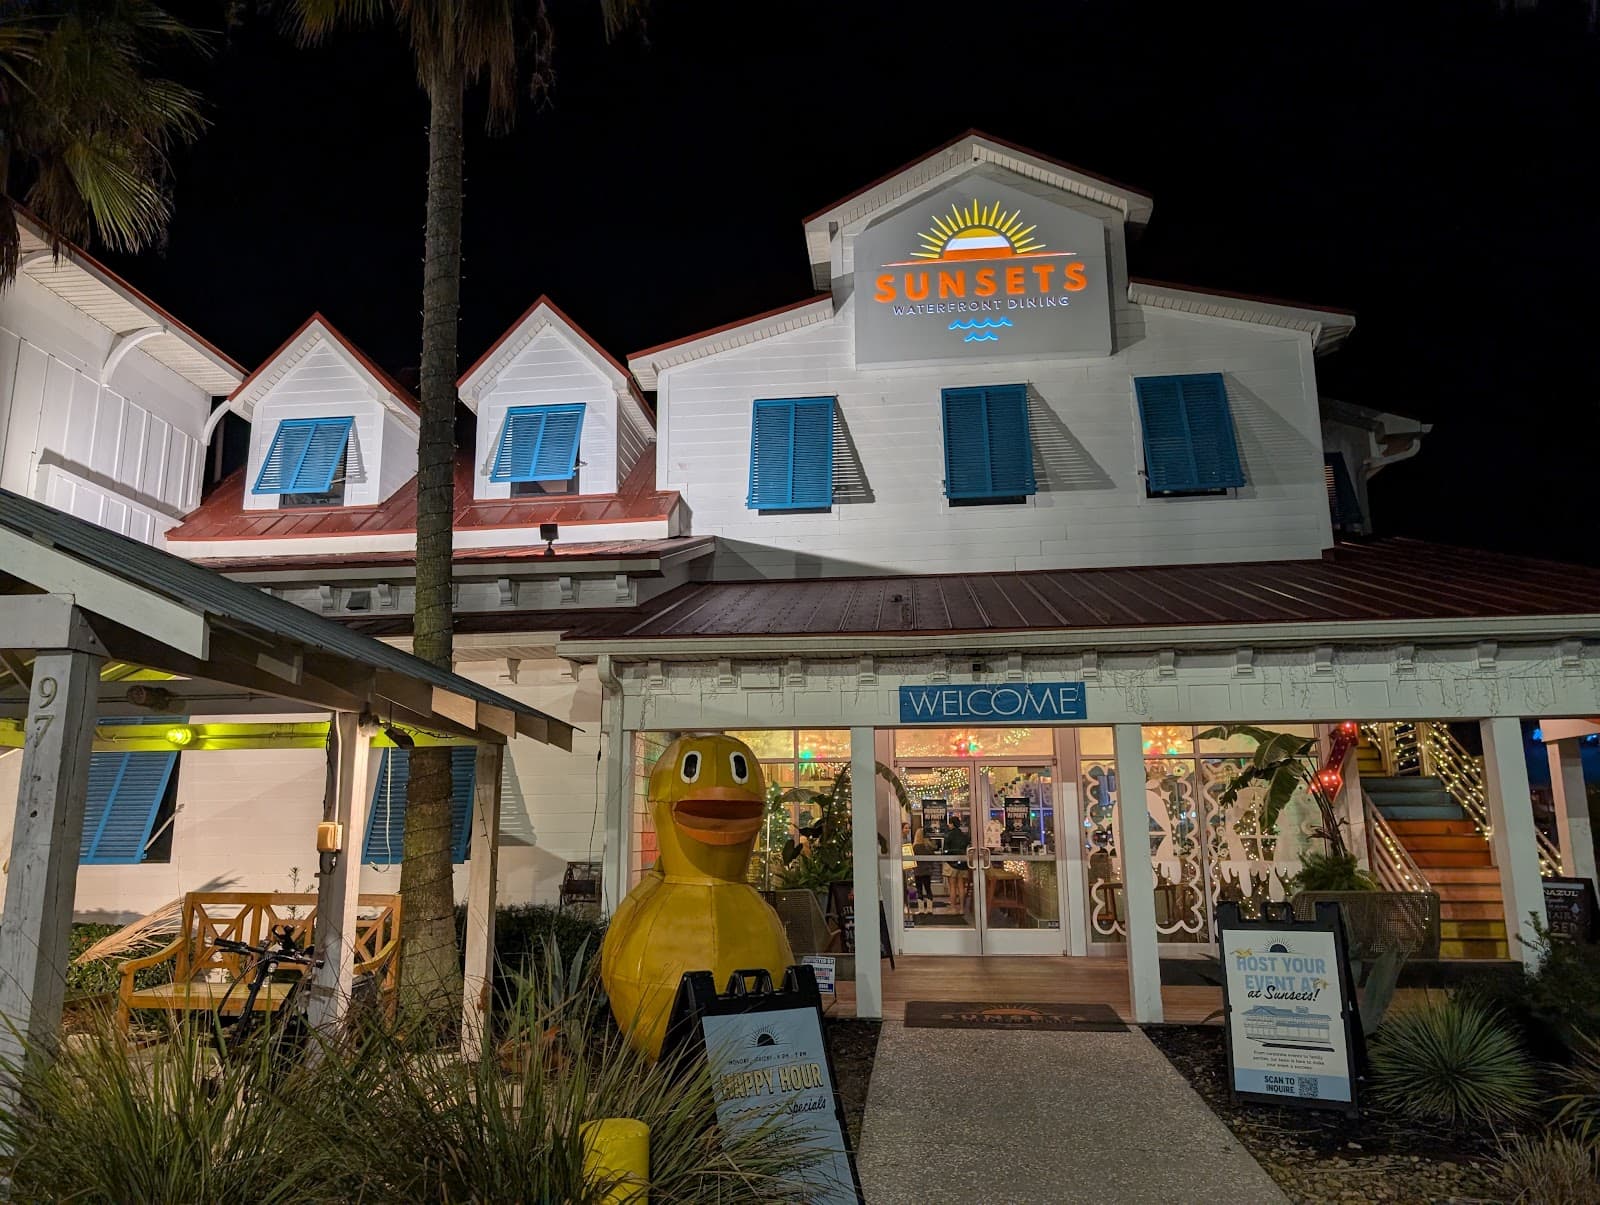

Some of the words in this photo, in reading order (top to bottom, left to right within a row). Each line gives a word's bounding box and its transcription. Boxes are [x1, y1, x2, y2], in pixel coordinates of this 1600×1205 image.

[874, 262, 1088, 303] SUNSETS
[893, 299, 1003, 316] WATERFRONT
[1007, 296, 1070, 310] DINING
[909, 687, 1078, 716] WELCOME
[1237, 957, 1276, 972] HOST
[1282, 957, 1325, 974] YOUR
[1245, 975, 1295, 992] EVENT
[1247, 989, 1261, 998] at
[1264, 985, 1320, 1001] Sunsets!
[720, 1068, 774, 1101] HAPPY
[779, 1063, 823, 1092] HOUR
[1264, 1075, 1283, 1084] SCAN
[1285, 1077, 1295, 1085] TO
[1266, 1084, 1295, 1093] INQUIRE
